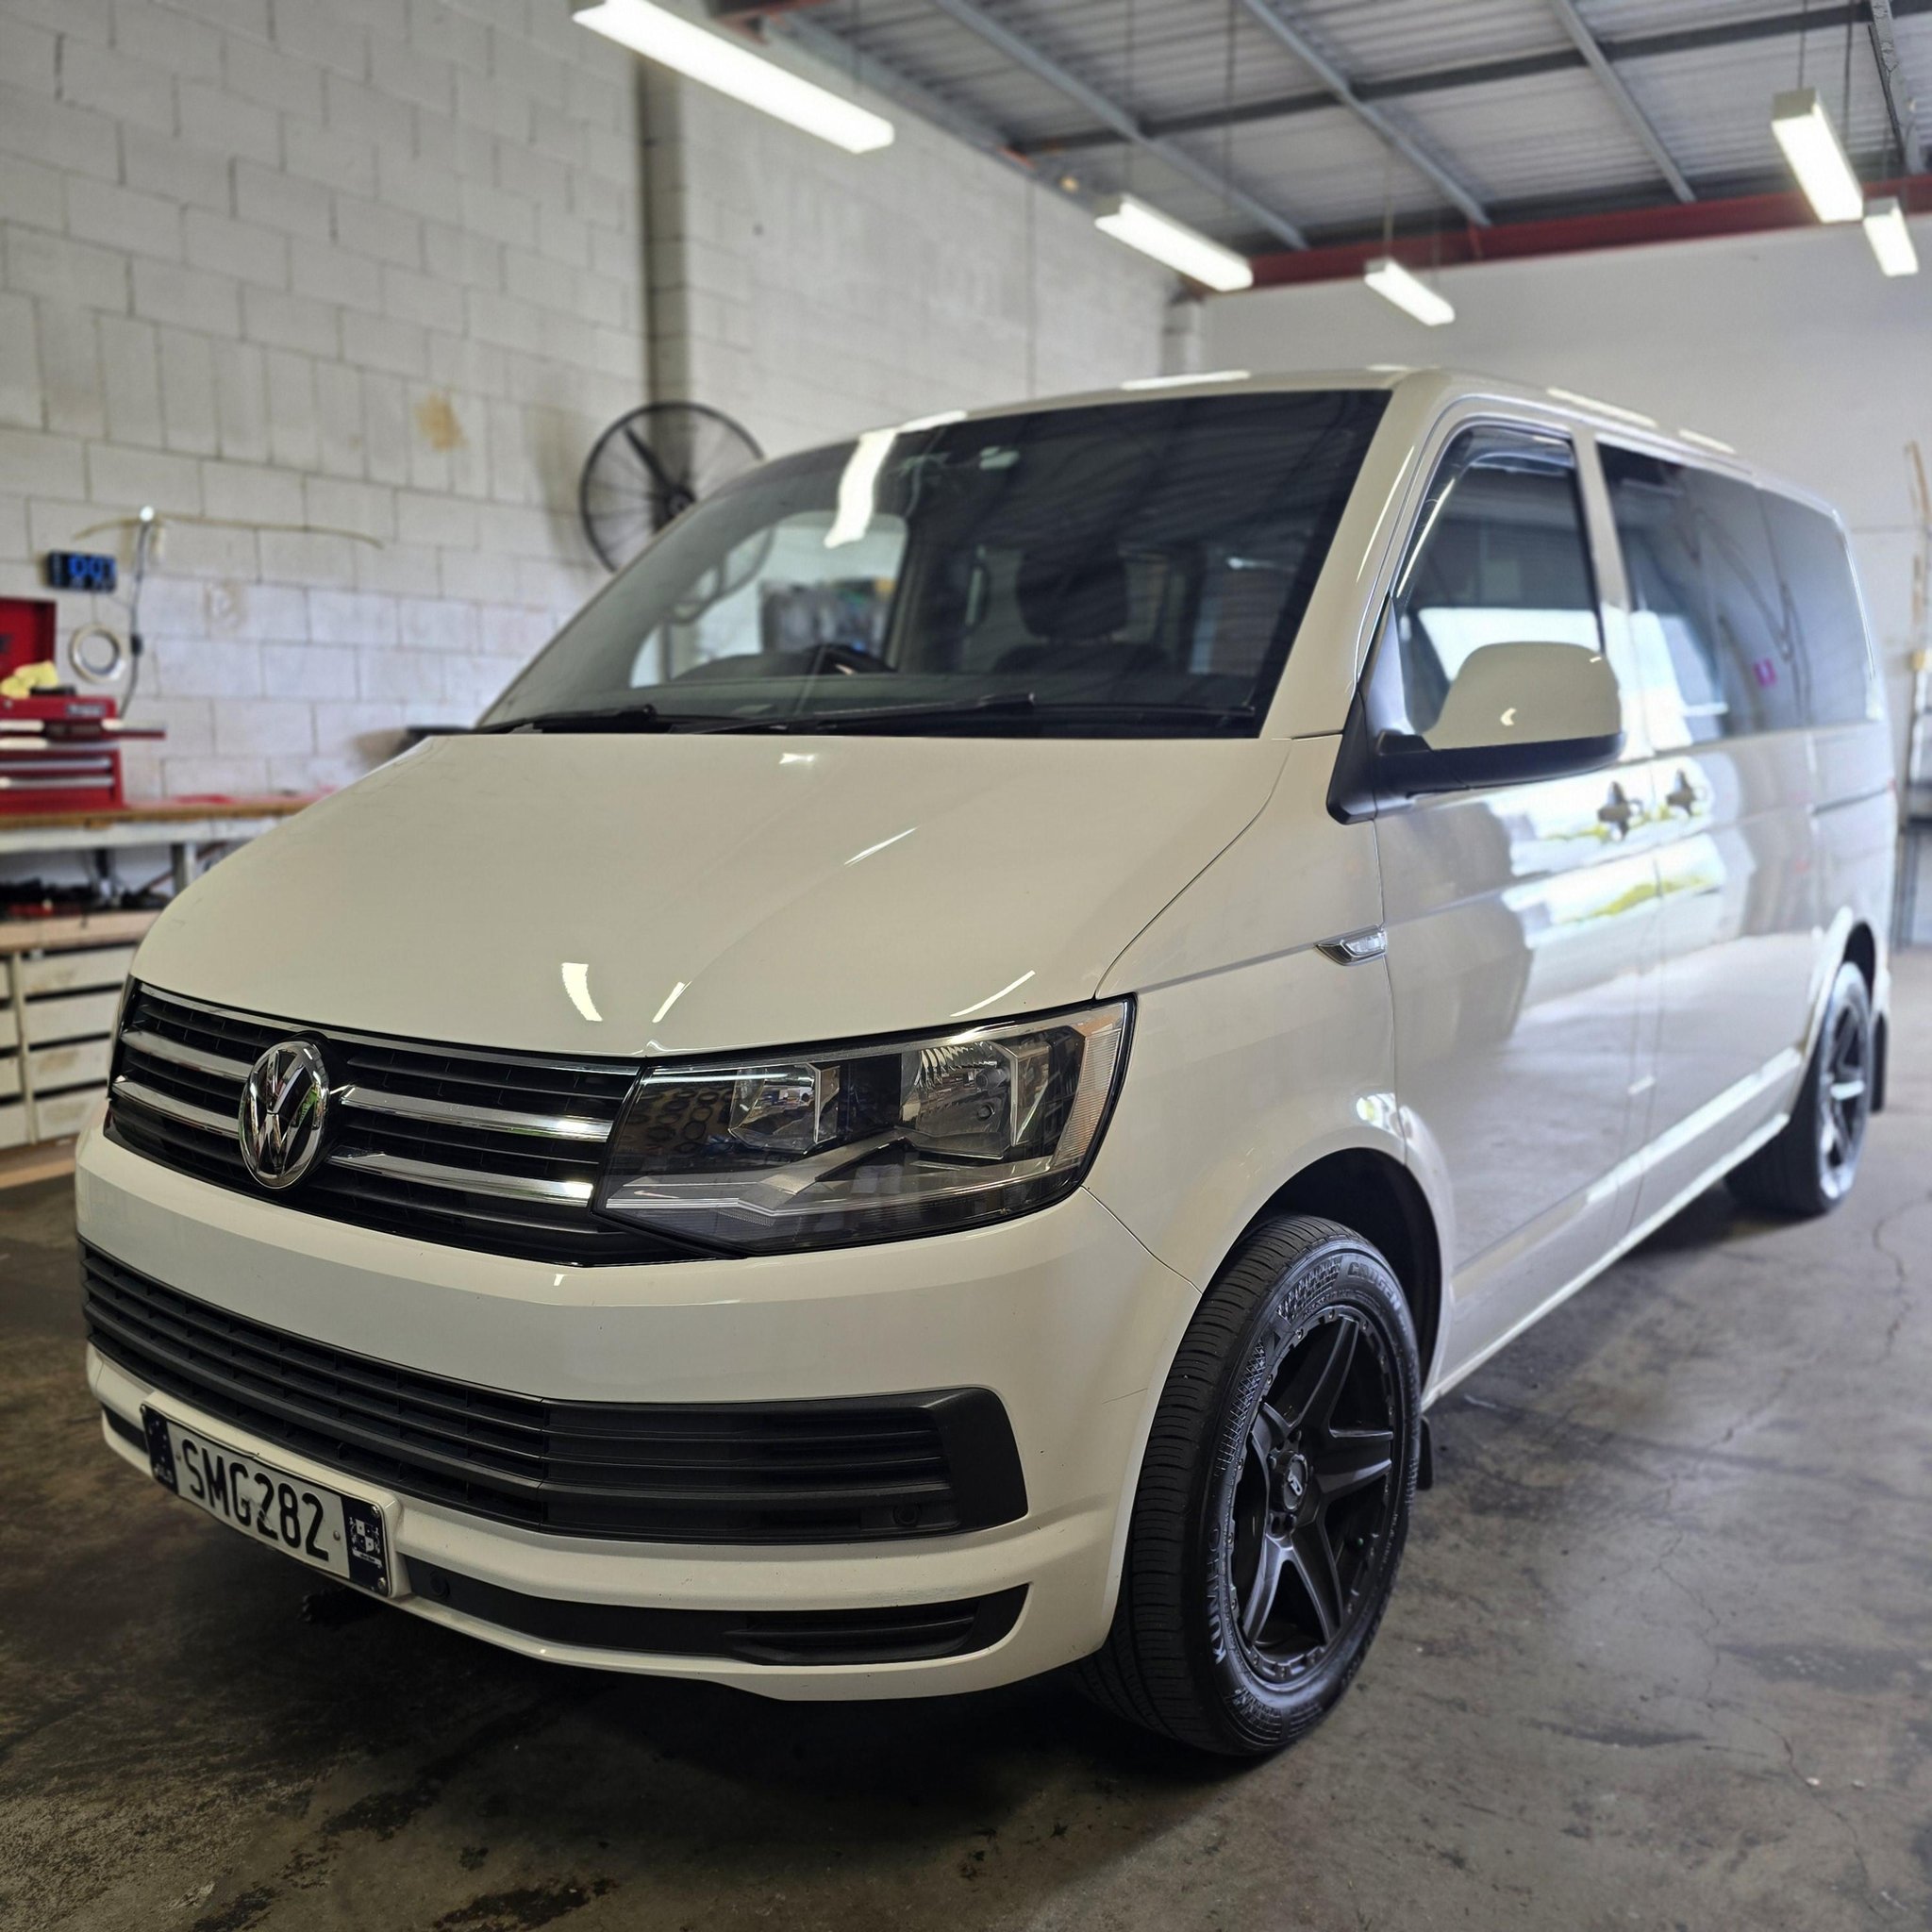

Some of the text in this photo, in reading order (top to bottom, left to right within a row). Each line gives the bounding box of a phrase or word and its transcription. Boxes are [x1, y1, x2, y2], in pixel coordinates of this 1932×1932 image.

[1347, 1261, 1401, 1311] CRUGEN
[181, 1439, 329, 1562] SMG282
[1207, 1523, 1226, 1665] KUMHO
